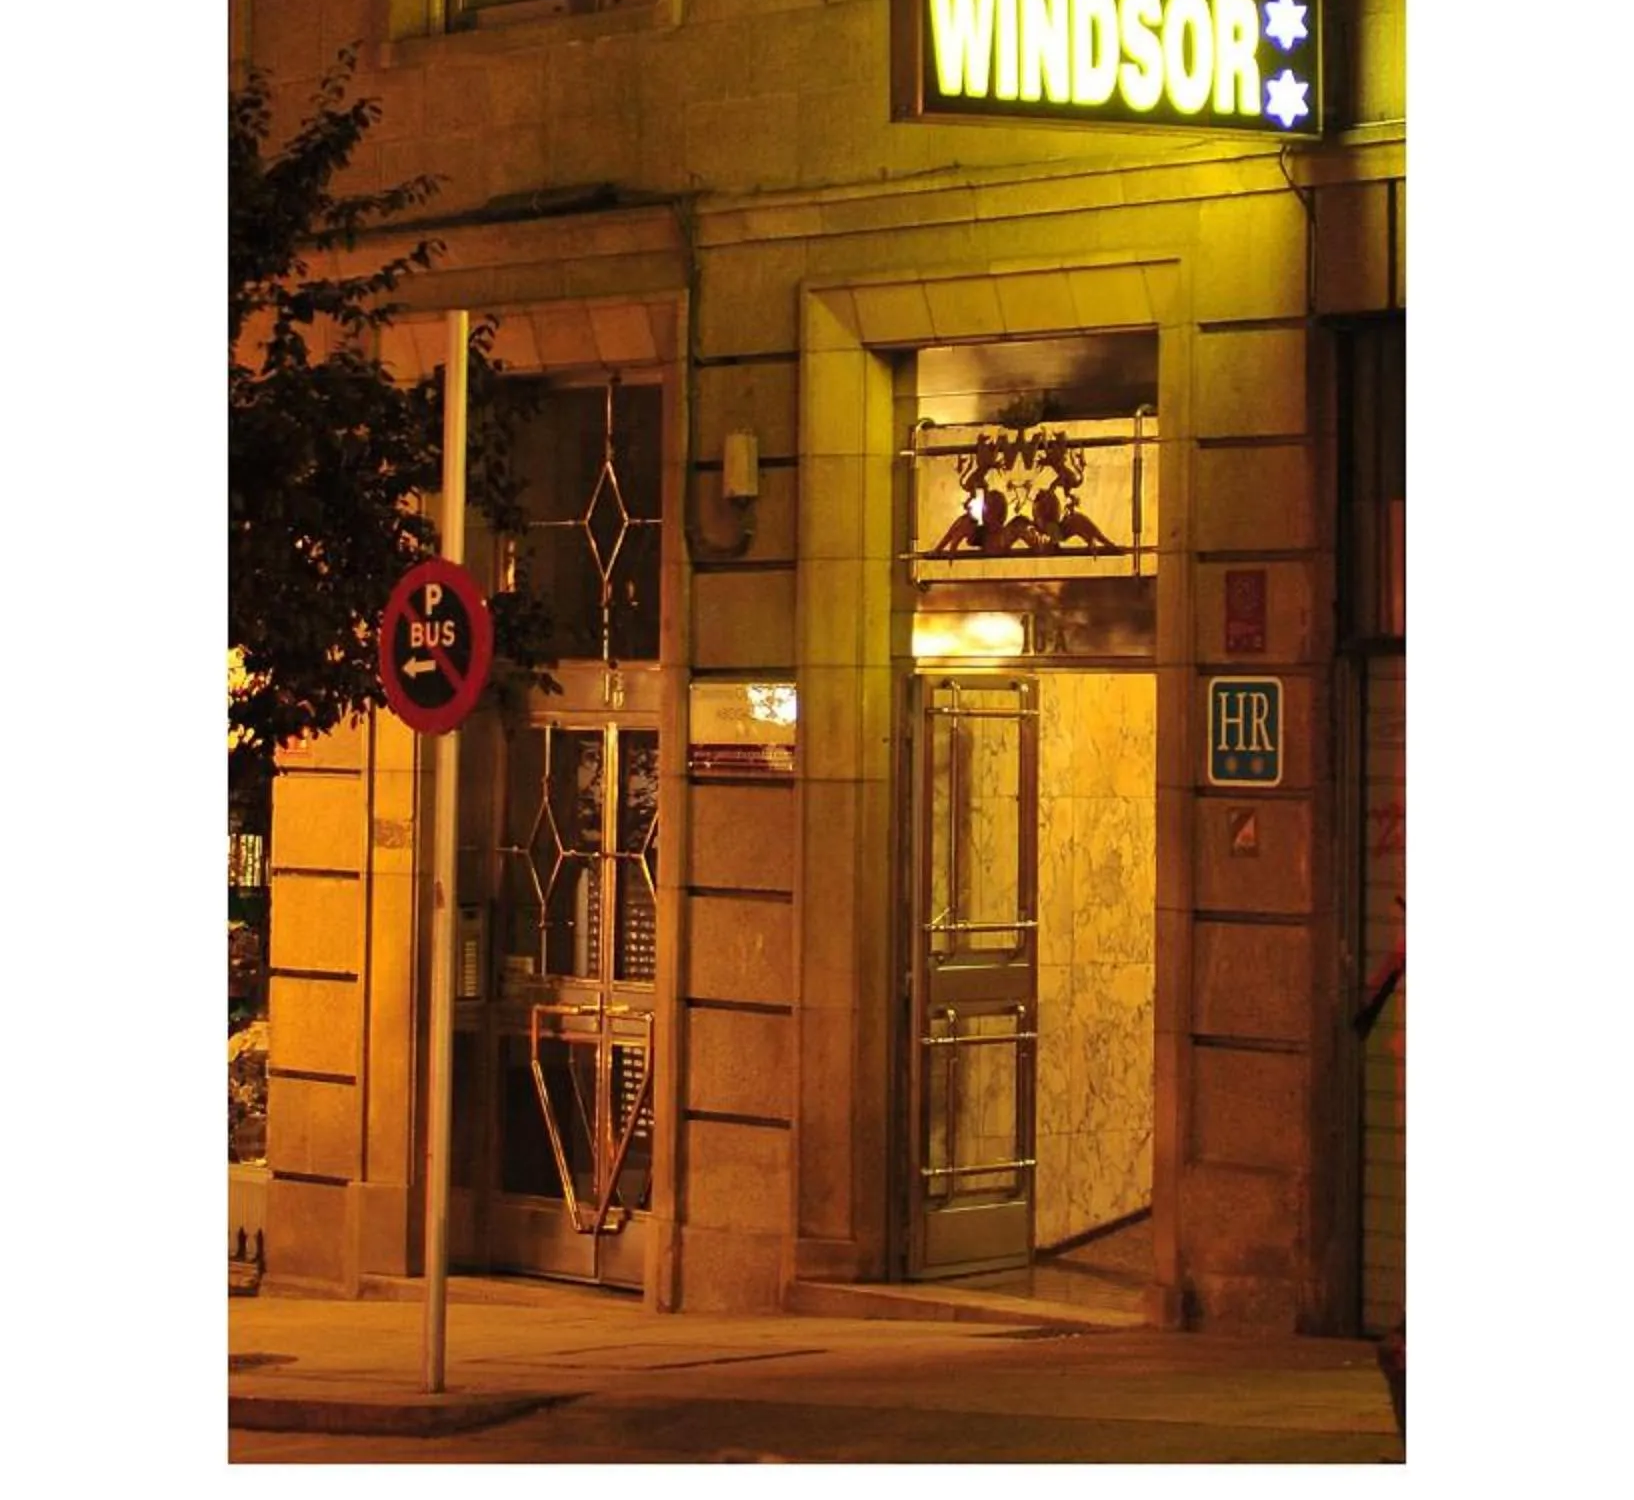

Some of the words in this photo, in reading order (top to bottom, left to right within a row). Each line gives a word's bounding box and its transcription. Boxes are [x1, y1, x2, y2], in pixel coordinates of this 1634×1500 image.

[424, 583, 442, 616] P
[410, 620, 455, 648] BUS
[1217, 691, 1274, 751] HR
